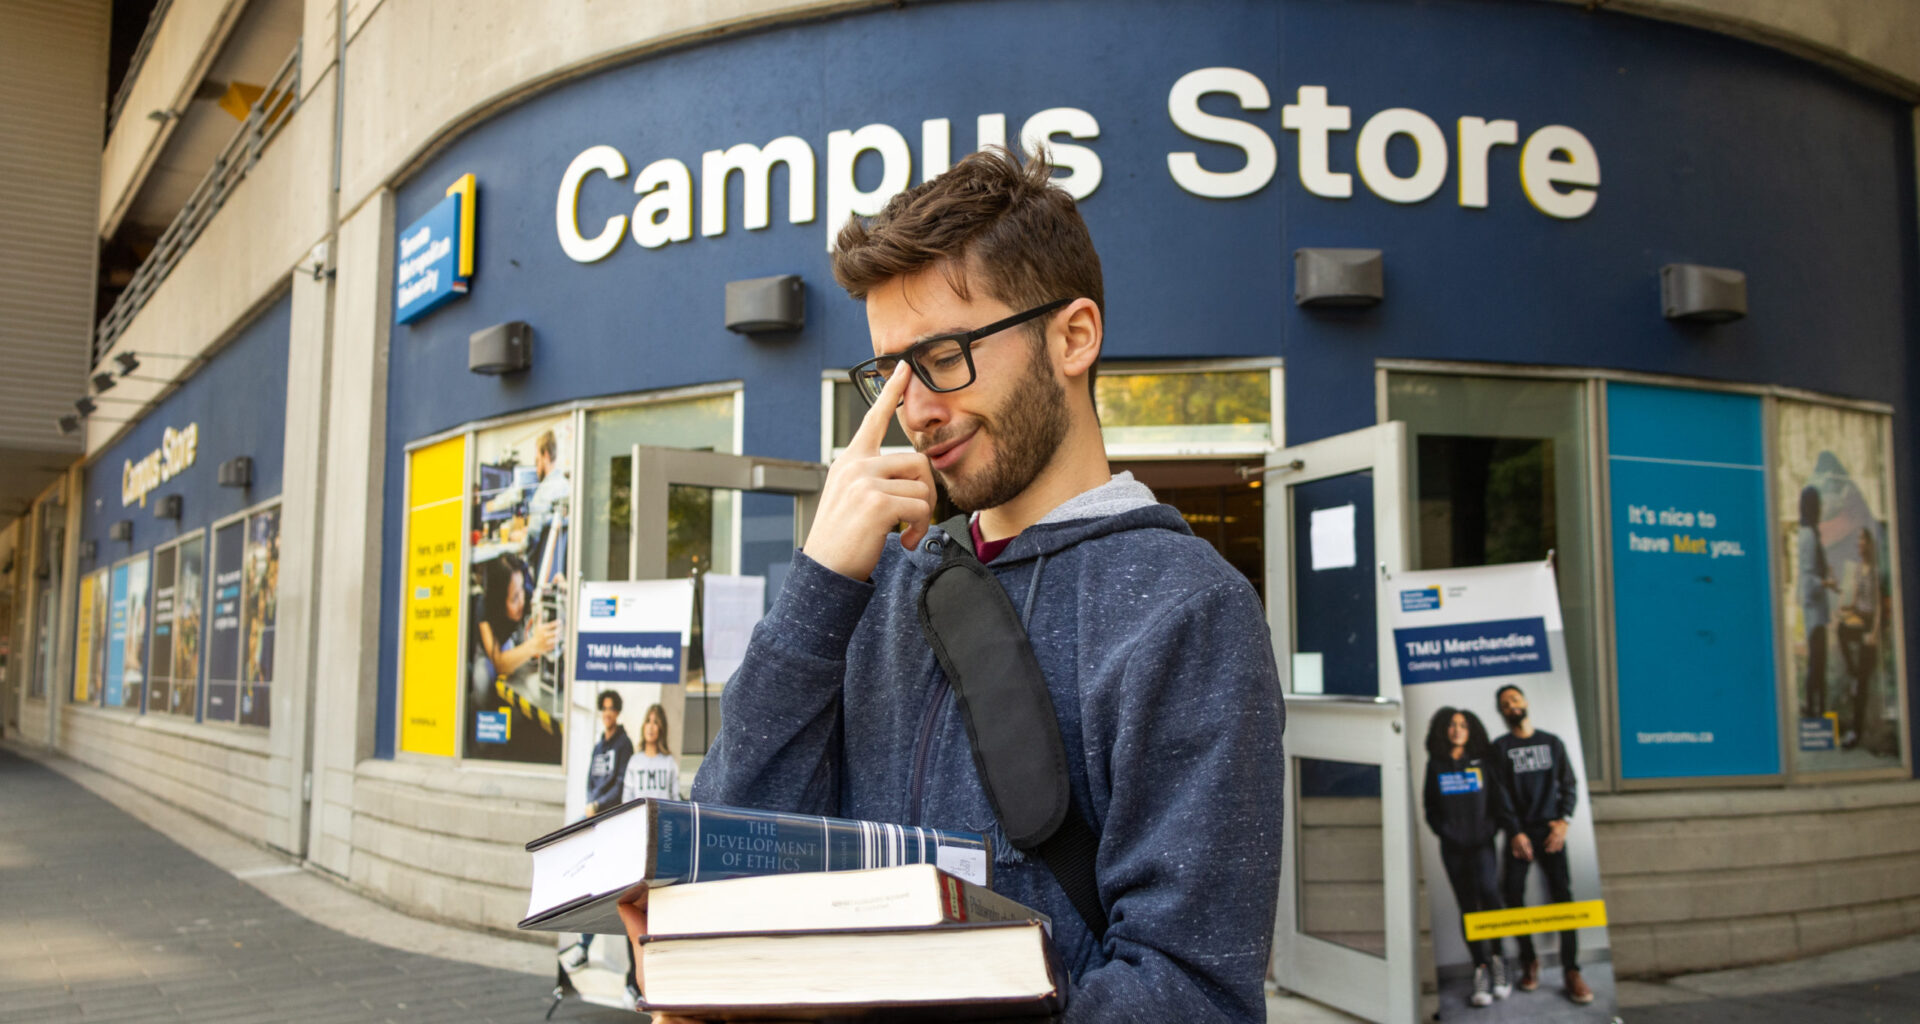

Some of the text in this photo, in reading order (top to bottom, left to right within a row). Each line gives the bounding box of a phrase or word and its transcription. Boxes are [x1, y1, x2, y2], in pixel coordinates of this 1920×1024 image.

[1167, 66, 1601, 219] Store
[122, 422, 198, 509] Campus Store
[1628, 504, 1717, 529] It's nice to
[1629, 531, 1746, 559] have Met you.
[587, 643, 674, 659] TMU Merchandise
[1406, 634, 1536, 657] TMU Merchandise
[1636, 731, 1714, 744] torontomu.ca
[1507, 744, 1553, 774] TMU
[637, 769, 669, 791] TMU
[663, 820, 673, 853] IRWIN
[747, 820, 777, 836] THE
[706, 833, 817, 857] DEVELOPMENT
[722, 852, 801, 872] OF ETHICS
